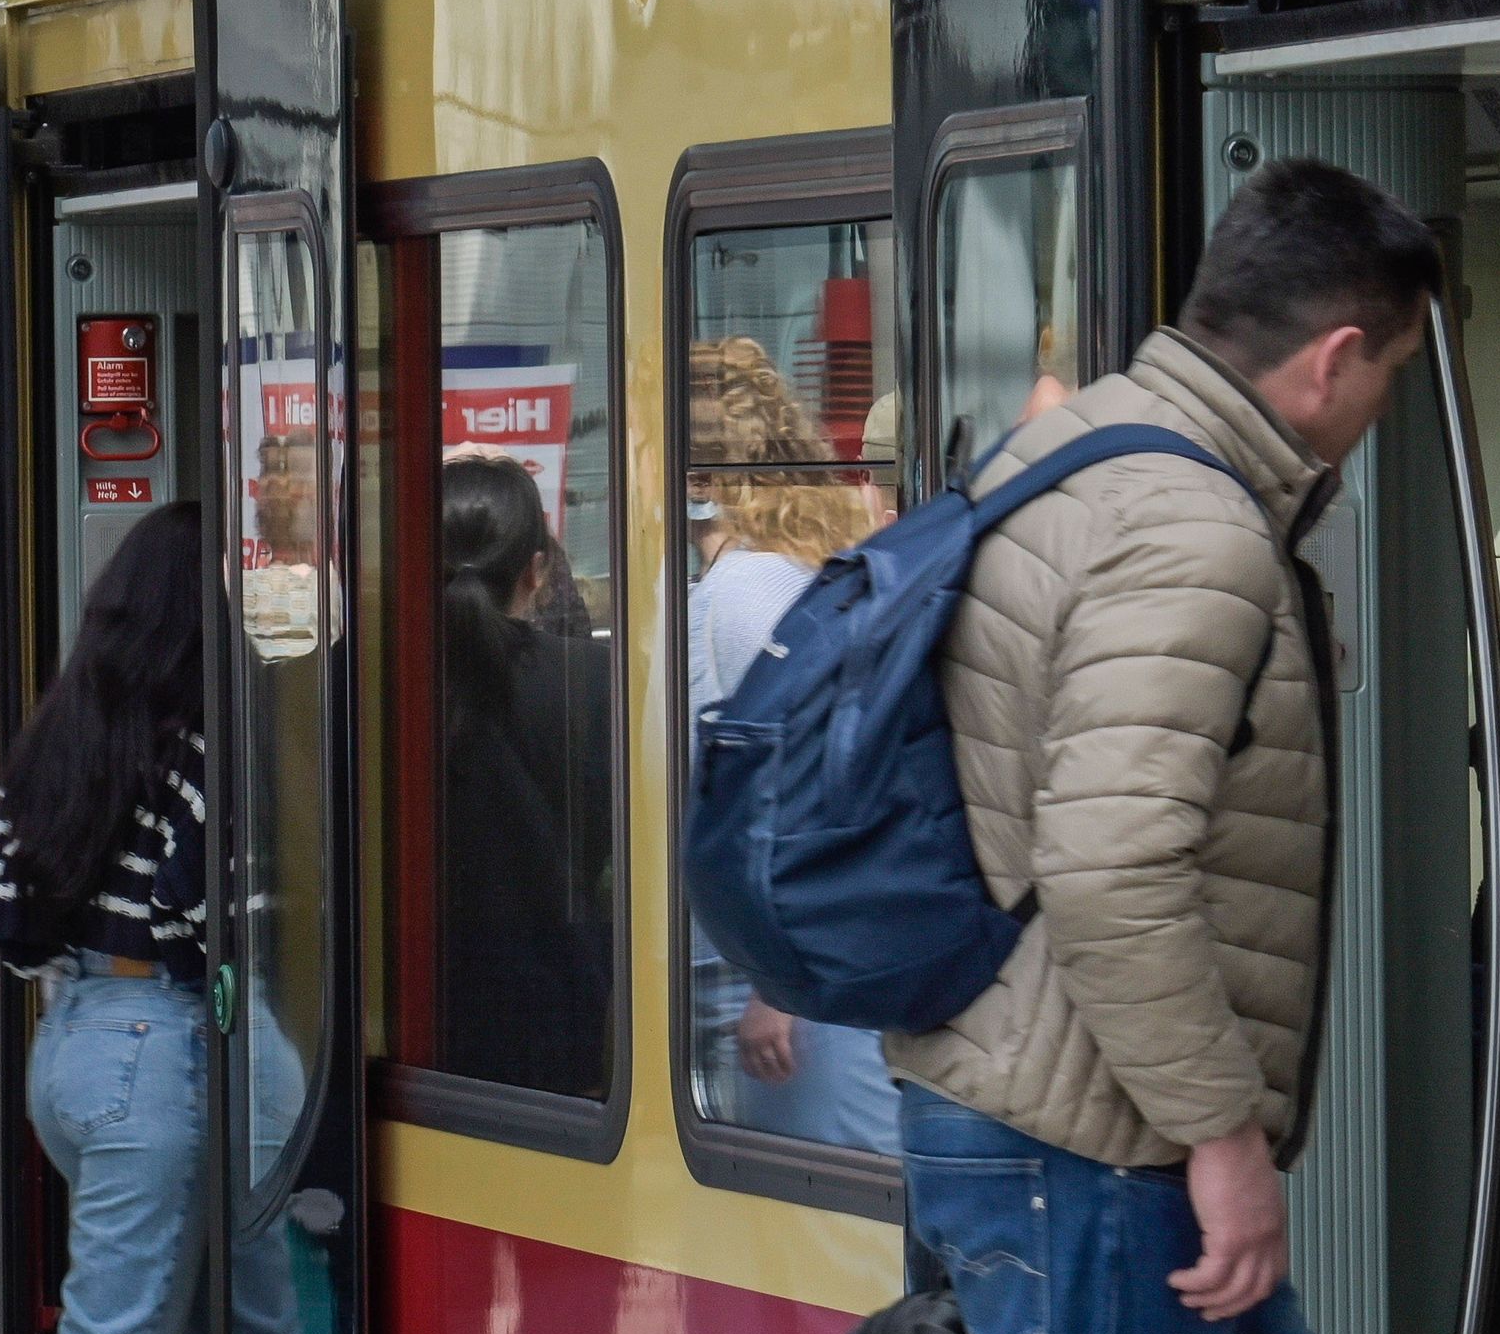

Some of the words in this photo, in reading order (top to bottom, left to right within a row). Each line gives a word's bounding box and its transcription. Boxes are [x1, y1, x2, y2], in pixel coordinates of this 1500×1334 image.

[96, 360, 124, 371] Alarm
[95, 481, 117, 491] Hilfe
[97, 490, 118, 501] Help
